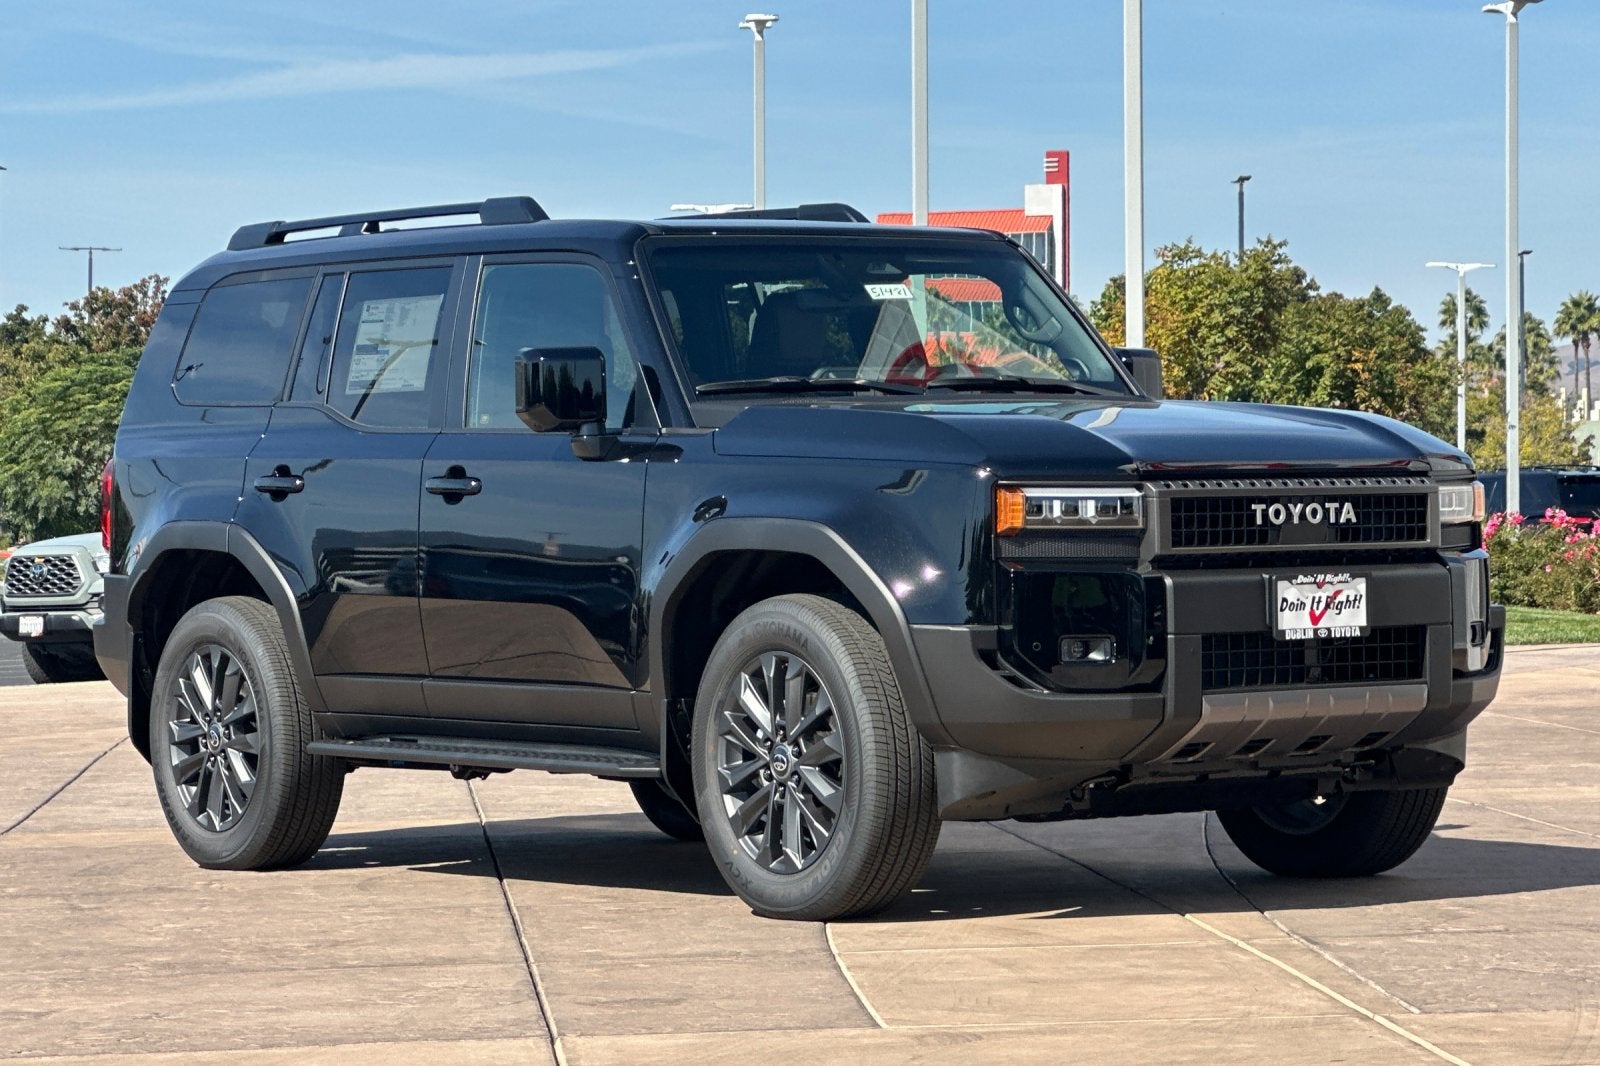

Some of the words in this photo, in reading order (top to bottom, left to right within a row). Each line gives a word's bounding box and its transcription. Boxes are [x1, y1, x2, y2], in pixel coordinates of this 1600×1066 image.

[1251, 502, 1357, 525] TOYOTA
[1310, 594, 1322, 611] It
[1325, 594, 1363, 616] Right!
[1285, 628, 1314, 640] DUBLIN
[1330, 626, 1361, 638] TOYOTA
